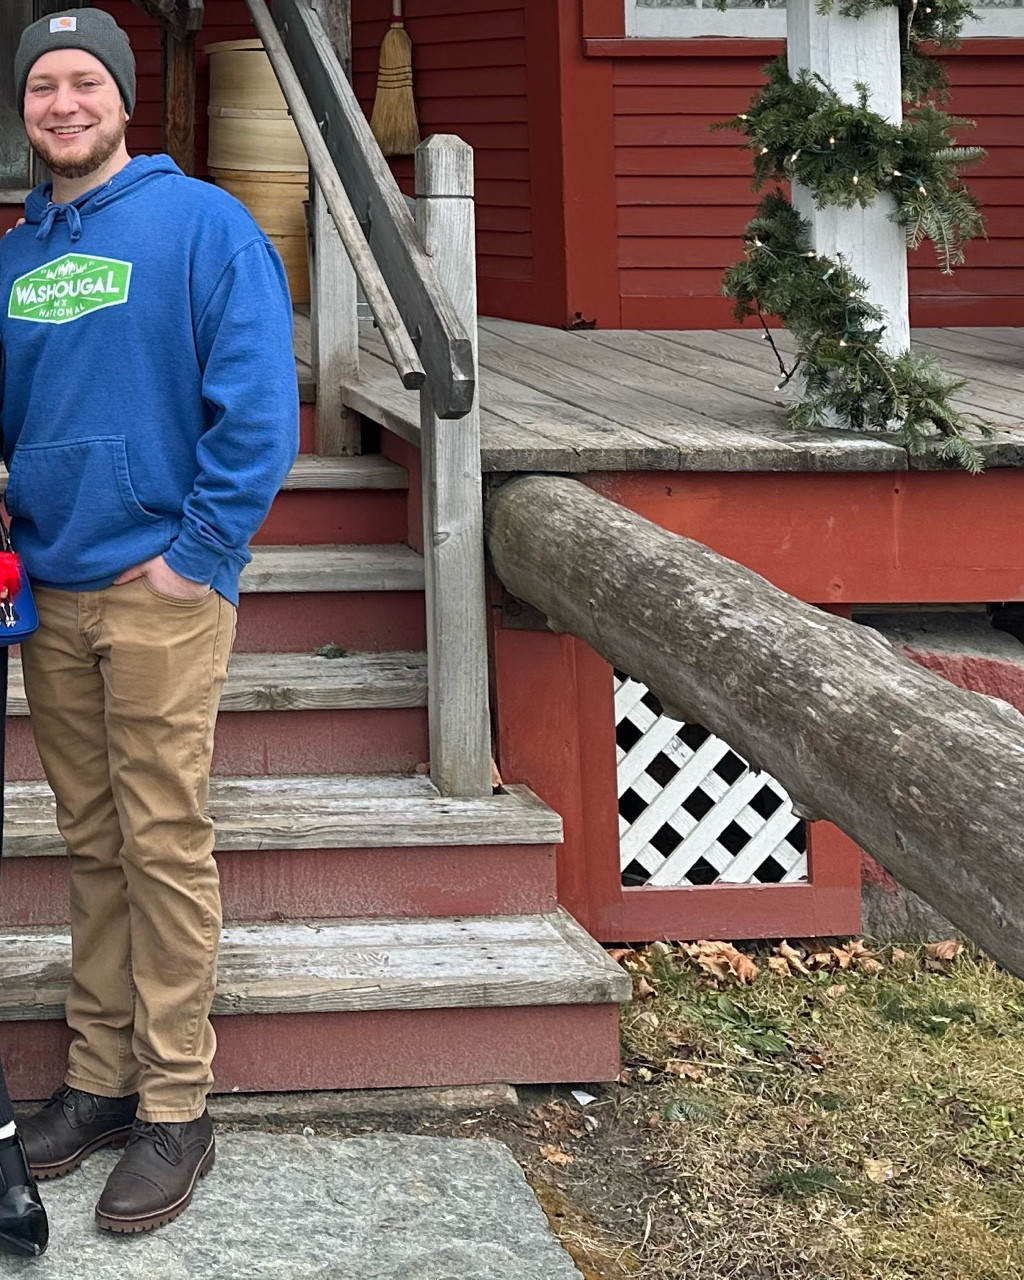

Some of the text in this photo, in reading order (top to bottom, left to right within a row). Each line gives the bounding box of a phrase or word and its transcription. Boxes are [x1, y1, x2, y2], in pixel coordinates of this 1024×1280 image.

[16, 271, 120, 306] WASHOUGAL
[53, 298, 68, 307] MX
[39, 303, 86, 318] NATIONAL
